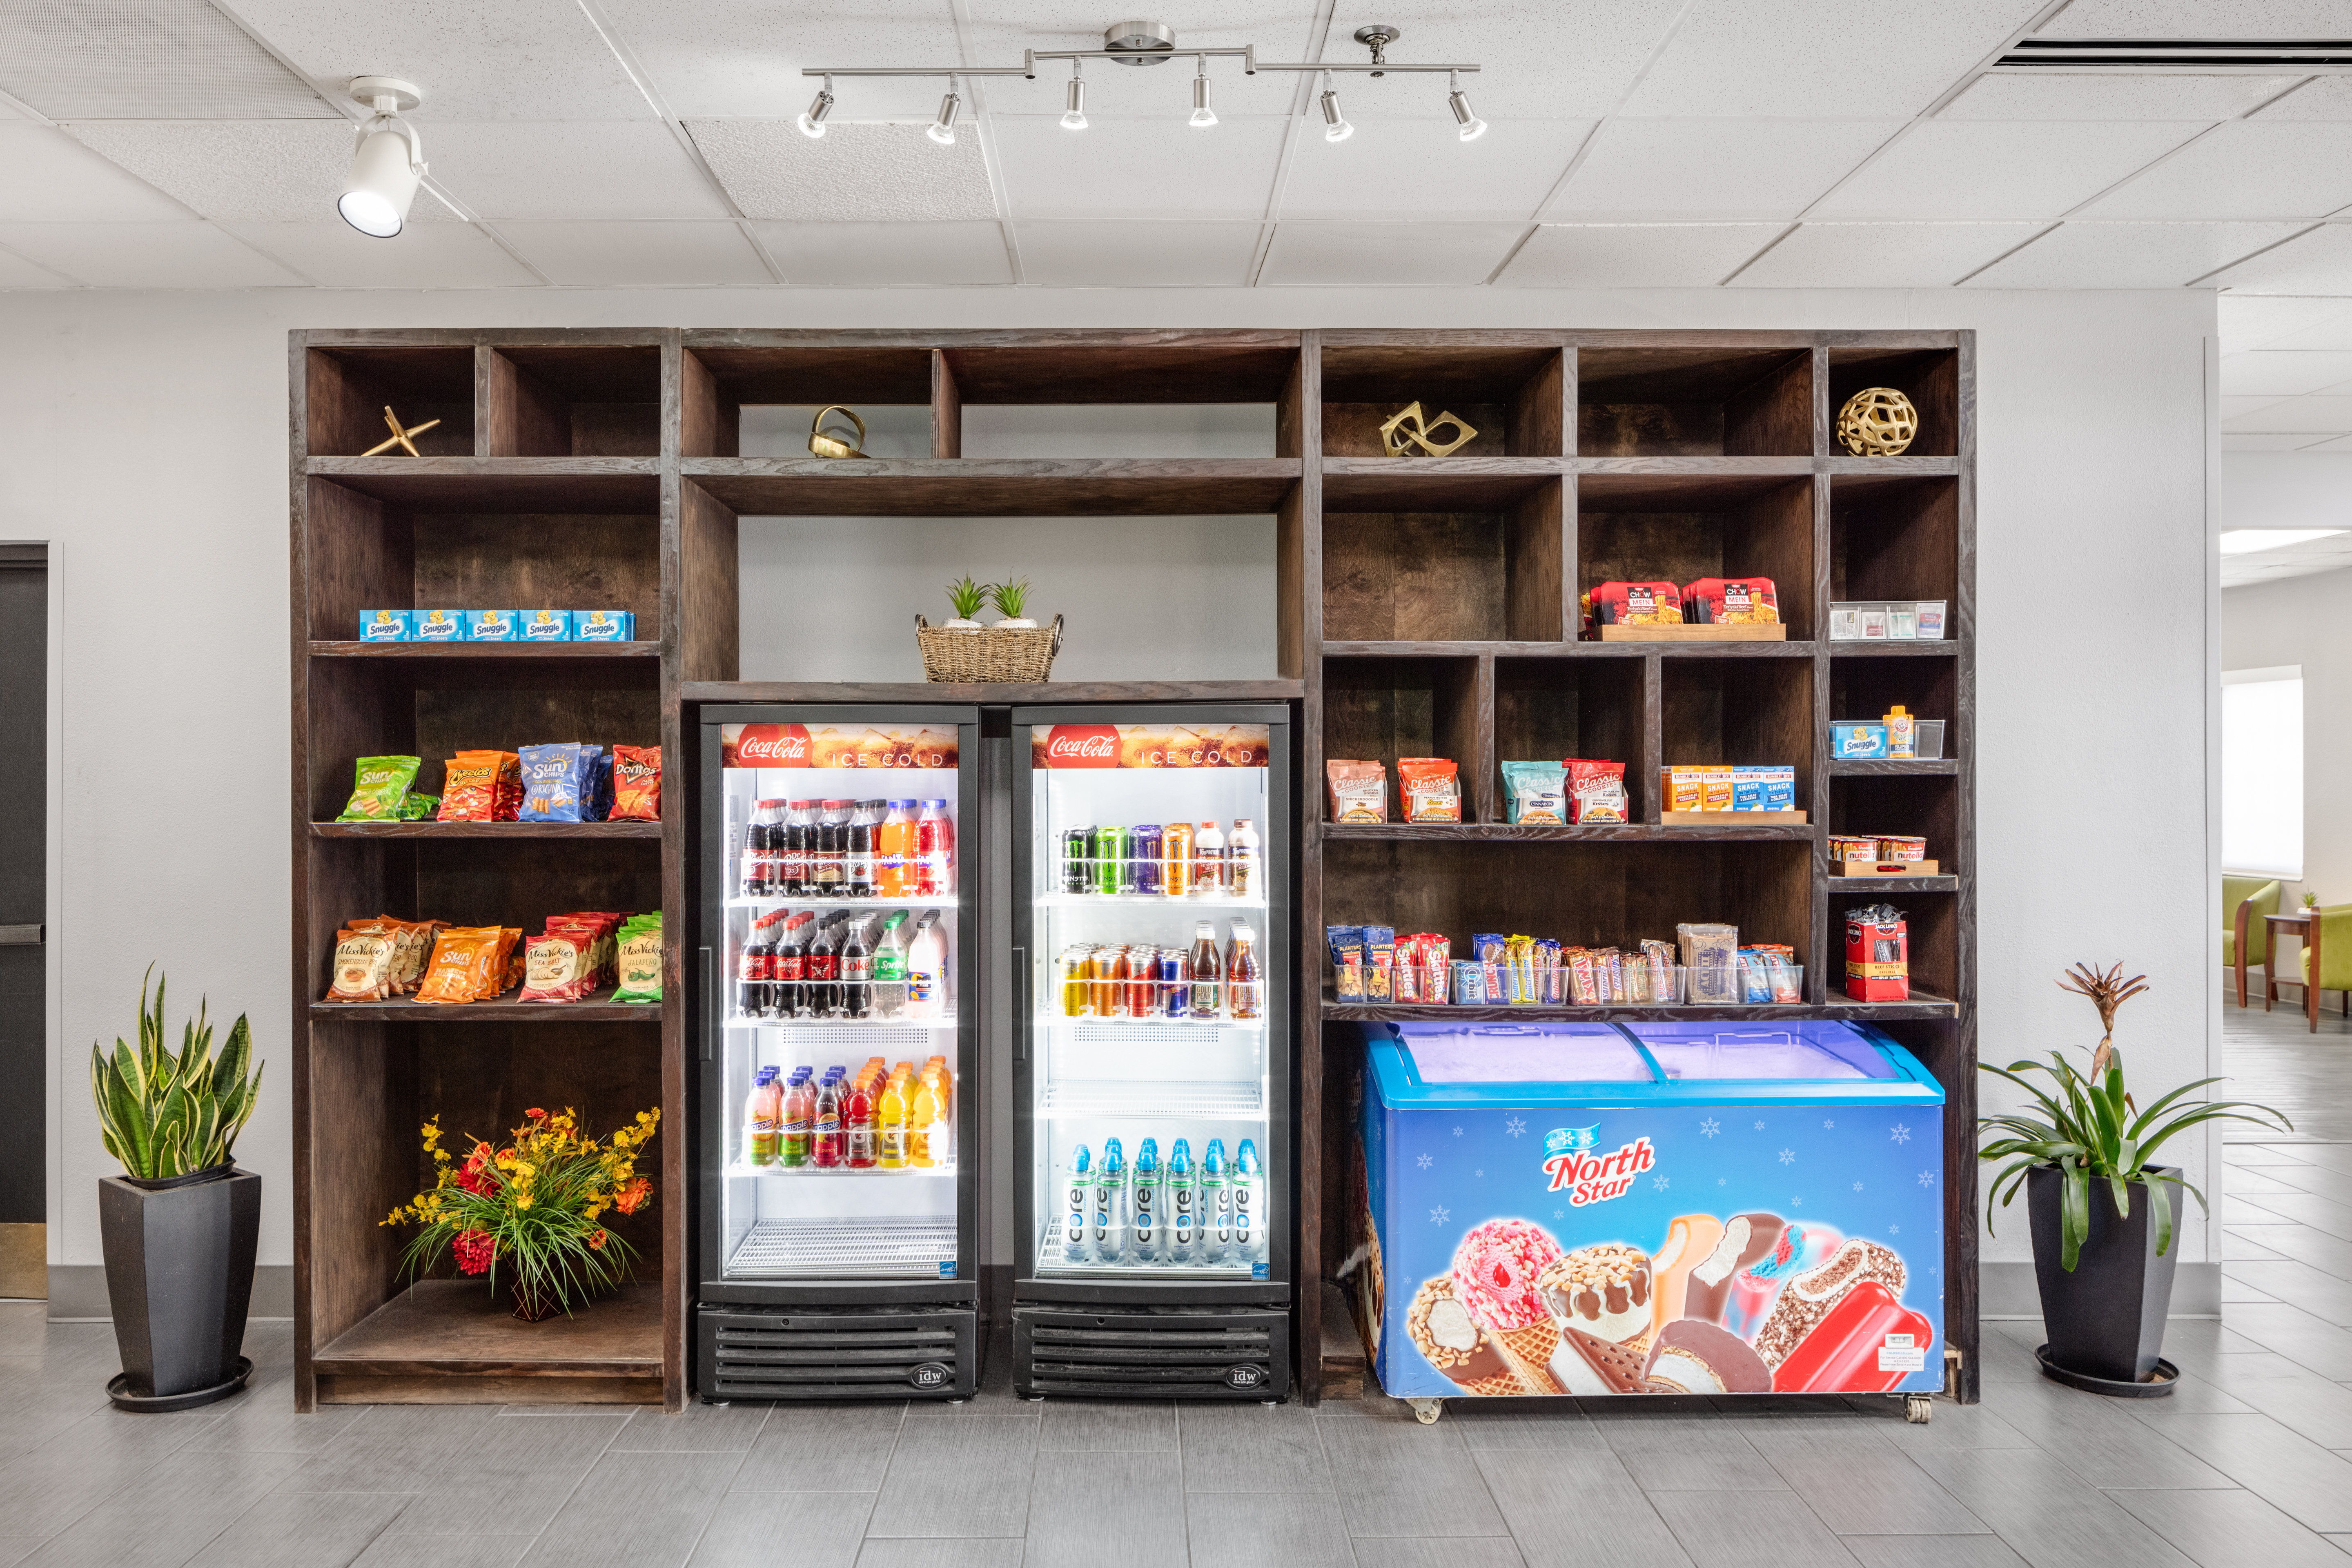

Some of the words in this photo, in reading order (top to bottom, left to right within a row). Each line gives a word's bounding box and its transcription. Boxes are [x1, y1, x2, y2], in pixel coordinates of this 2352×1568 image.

[370, 623, 400, 634] Snuggle
[423, 623, 452, 634] Snuggle
[477, 623, 506, 635] Snuggle
[530, 623, 559, 634] Snuggle
[584, 624, 615, 635] Snuggle
[741, 737, 808, 758] Coca-Cola
[1050, 736, 1118, 757] Coca-Cola
[1847, 739, 1876, 751] Snuggle
[833, 754, 867, 766] ICE
[882, 754, 943, 766] COLD
[1142, 752, 1176, 764] ICE
[1192, 751, 1252, 763] COLD
[532, 763, 566, 779] Sun
[616, 764, 656, 775] Doritos
[449, 768, 492, 786] Cheetos
[460, 777, 480, 786] Crunchy
[1334, 775, 1376, 791] Classic
[1411, 775, 1451, 790] Classic
[1577, 773, 1620, 791] Classic
[1588, 783, 1613, 793] COOKIE
[1677, 783, 1698, 791] SNACK
[1707, 783, 1729, 791] SNACK
[1737, 783, 1759, 791] SNACK
[1768, 783, 1790, 791] SNACK
[337, 944, 359, 956] Miss
[359, 943, 385, 958] Vickie's
[842, 959, 869, 971] Coke
[881, 960, 904, 970] Sprite
[1739, 957, 1749, 969] LIF
[1396, 949, 1414, 998] Skittles
[1523, 958, 1533, 999] Butterfinger
[1574, 956, 1595, 997] TWIX
[1484, 962, 1501, 999] CRUNCH
[751, 1120, 773, 1130] apple
[1546, 1140, 1652, 1189] North
[1573, 1178, 1631, 1204] Star
[1069, 1189, 1083, 1242] core
[919, 1370, 942, 1381] idw
[1234, 1370, 1256, 1381] idw
